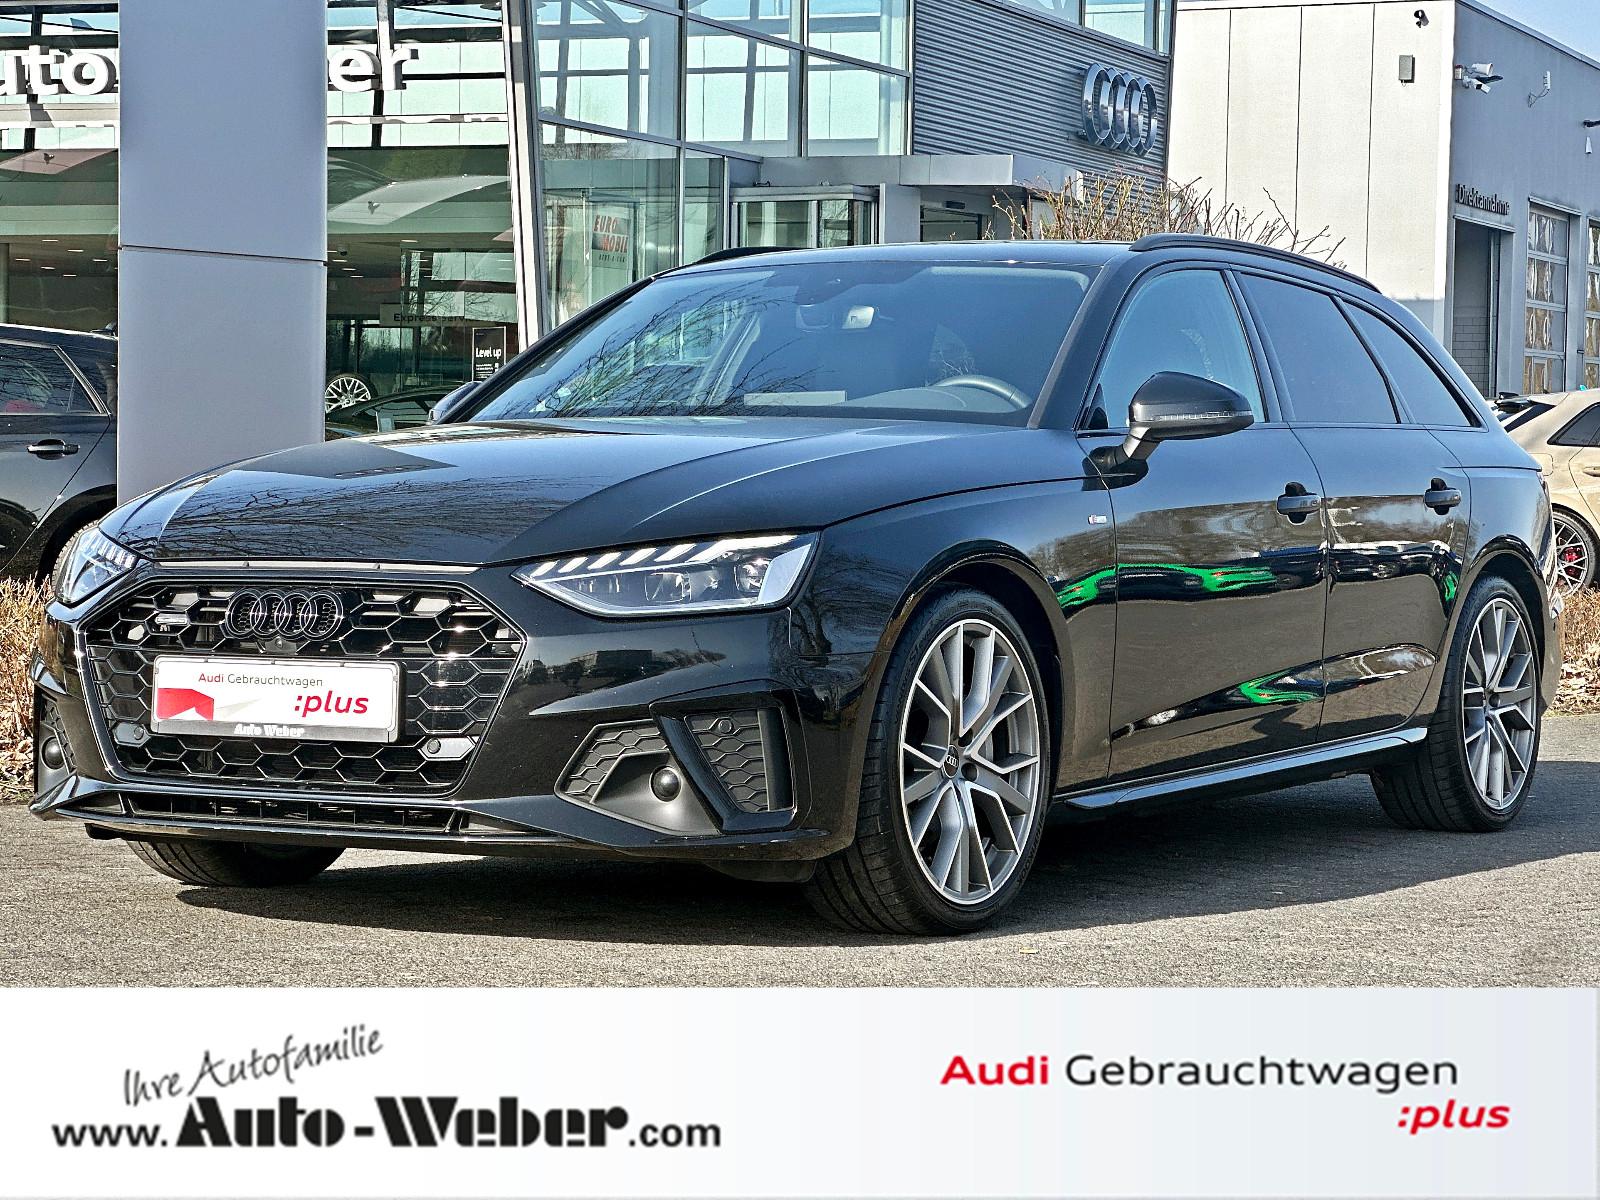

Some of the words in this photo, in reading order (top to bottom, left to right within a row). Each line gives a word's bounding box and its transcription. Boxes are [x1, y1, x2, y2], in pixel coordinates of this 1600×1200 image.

[594, 215, 618, 232] EURO
[603, 235, 628, 253] MOBIL
[475, 346, 492, 358] Level
[493, 348, 502, 360] up
[198, 673, 224, 683] Audi
[227, 673, 323, 688] Gebrauchtwagen
[294, 690, 369, 718] :plus
[234, 723, 262, 736] Auto
[264, 725, 305, 738] Weber
